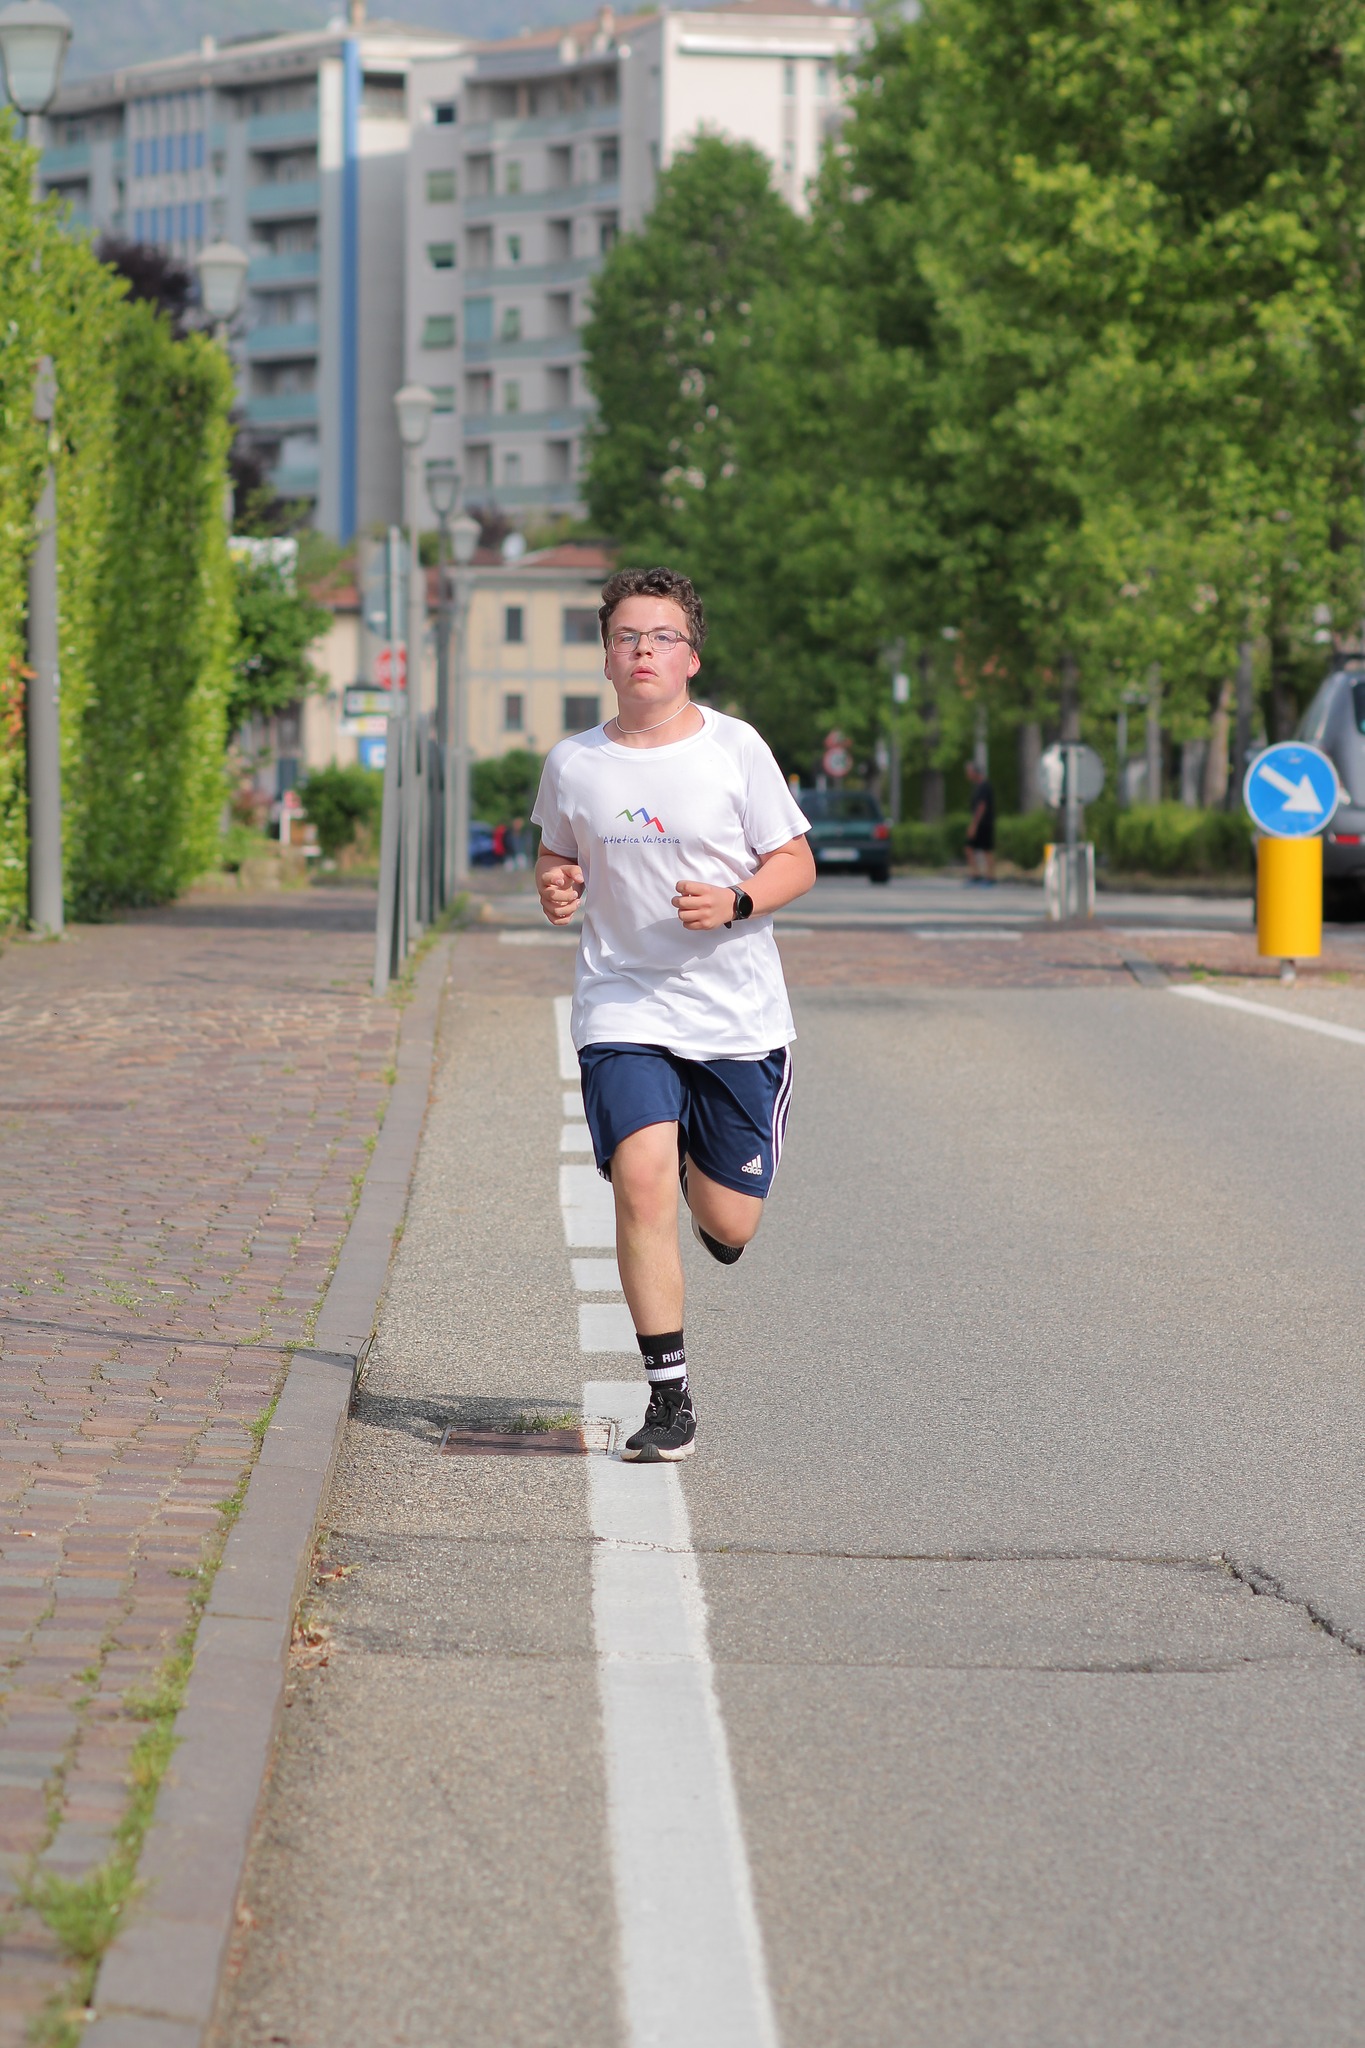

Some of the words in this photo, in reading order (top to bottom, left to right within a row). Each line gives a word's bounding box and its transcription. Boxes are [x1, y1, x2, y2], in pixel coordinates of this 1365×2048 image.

[603, 835, 640, 844] Atletica
[642, 834, 681, 844] Valsesia
[741, 1165, 763, 1176] adidas
